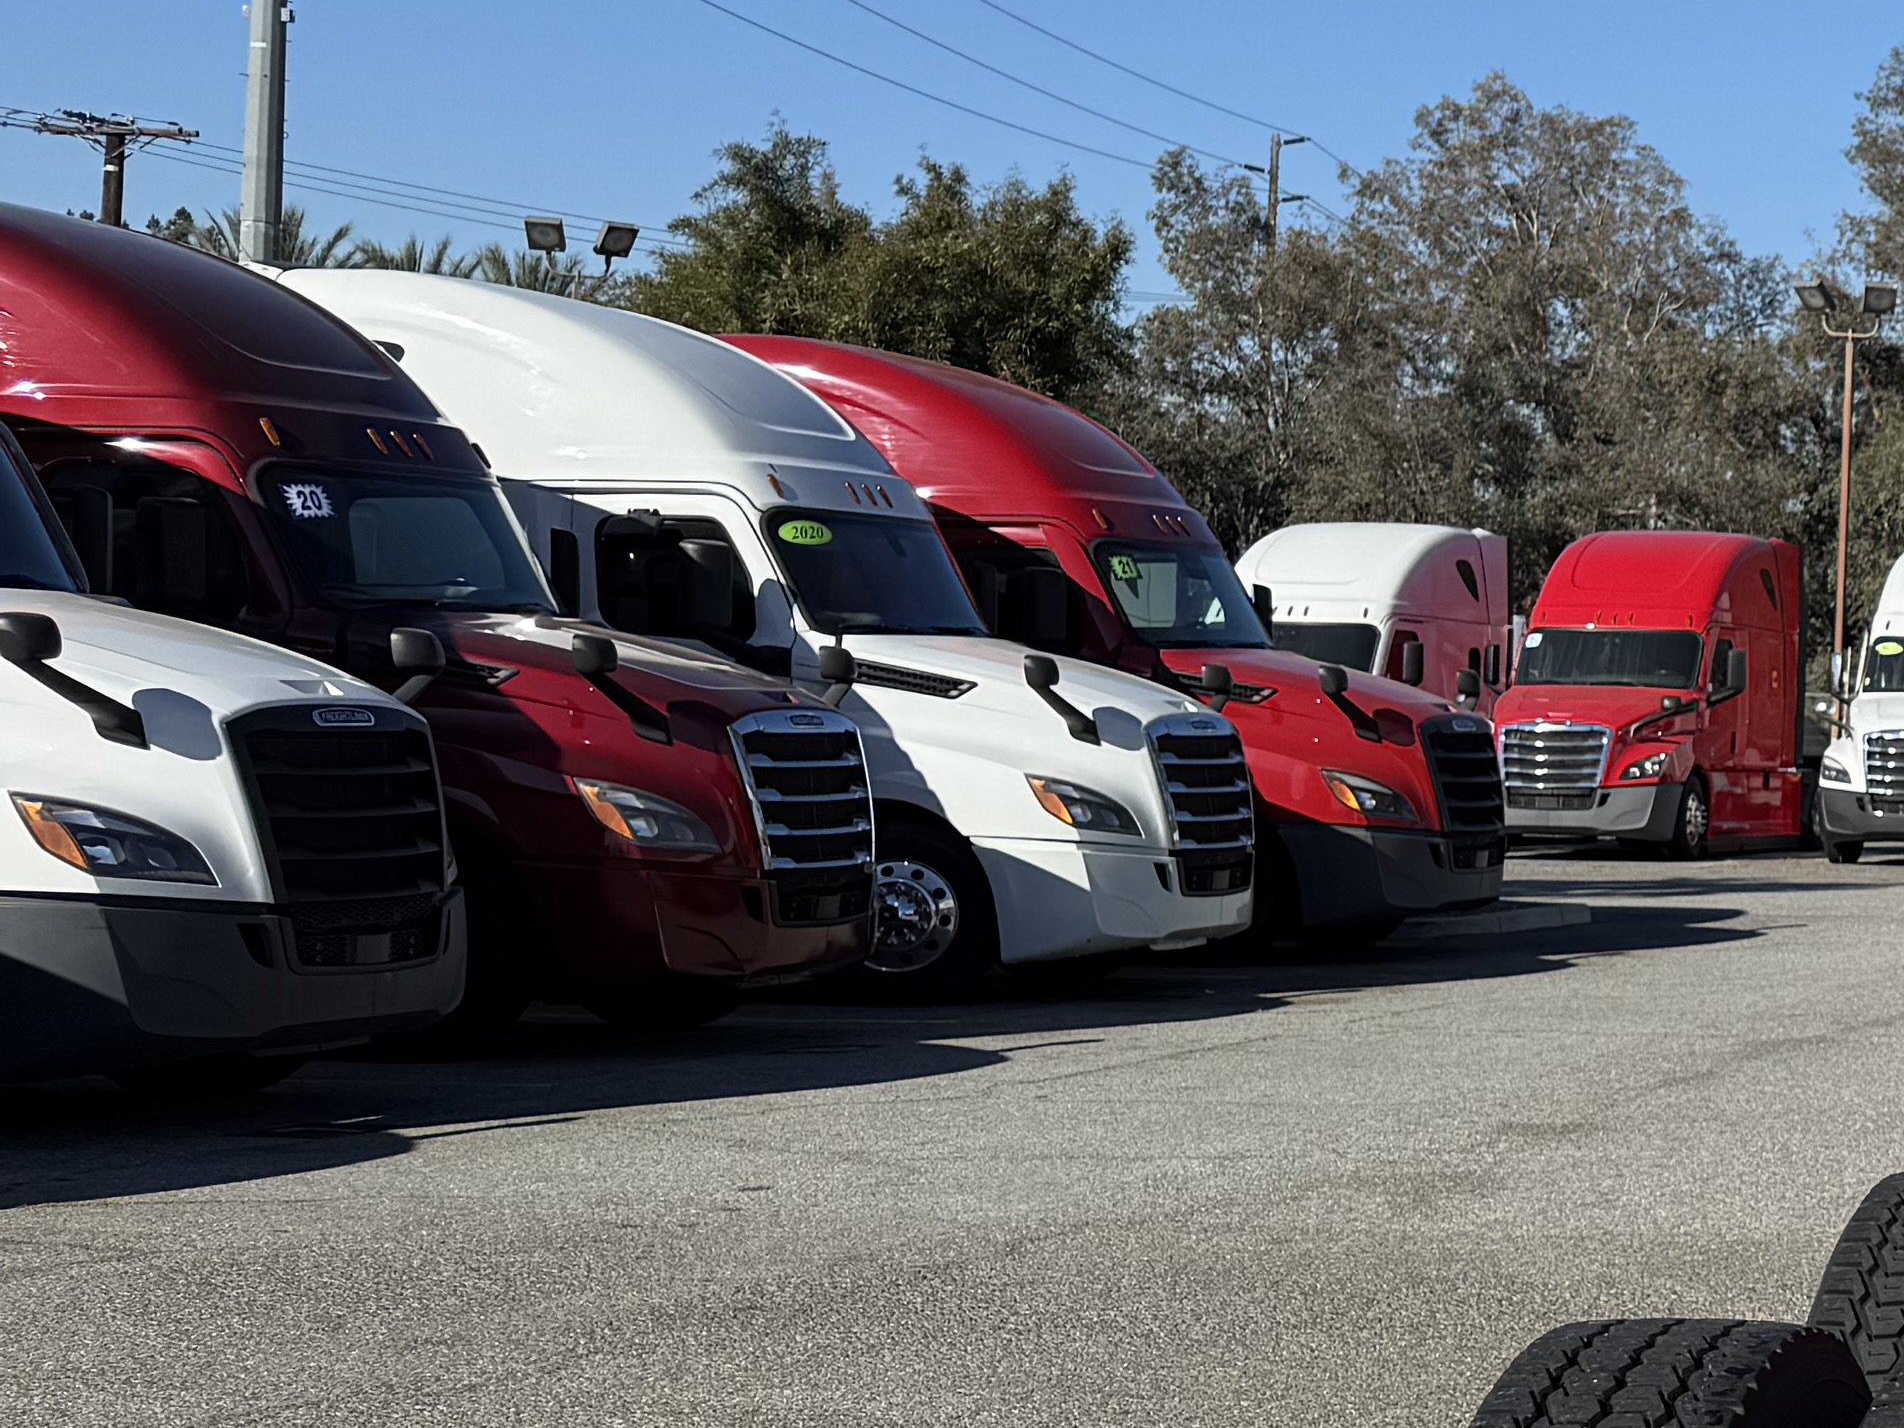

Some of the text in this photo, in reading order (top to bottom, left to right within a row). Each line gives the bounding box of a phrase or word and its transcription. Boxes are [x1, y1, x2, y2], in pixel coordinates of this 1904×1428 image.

[296, 489, 323, 511] 20
[791, 525, 824, 540] 2020
[1117, 559, 1134, 575] 21
